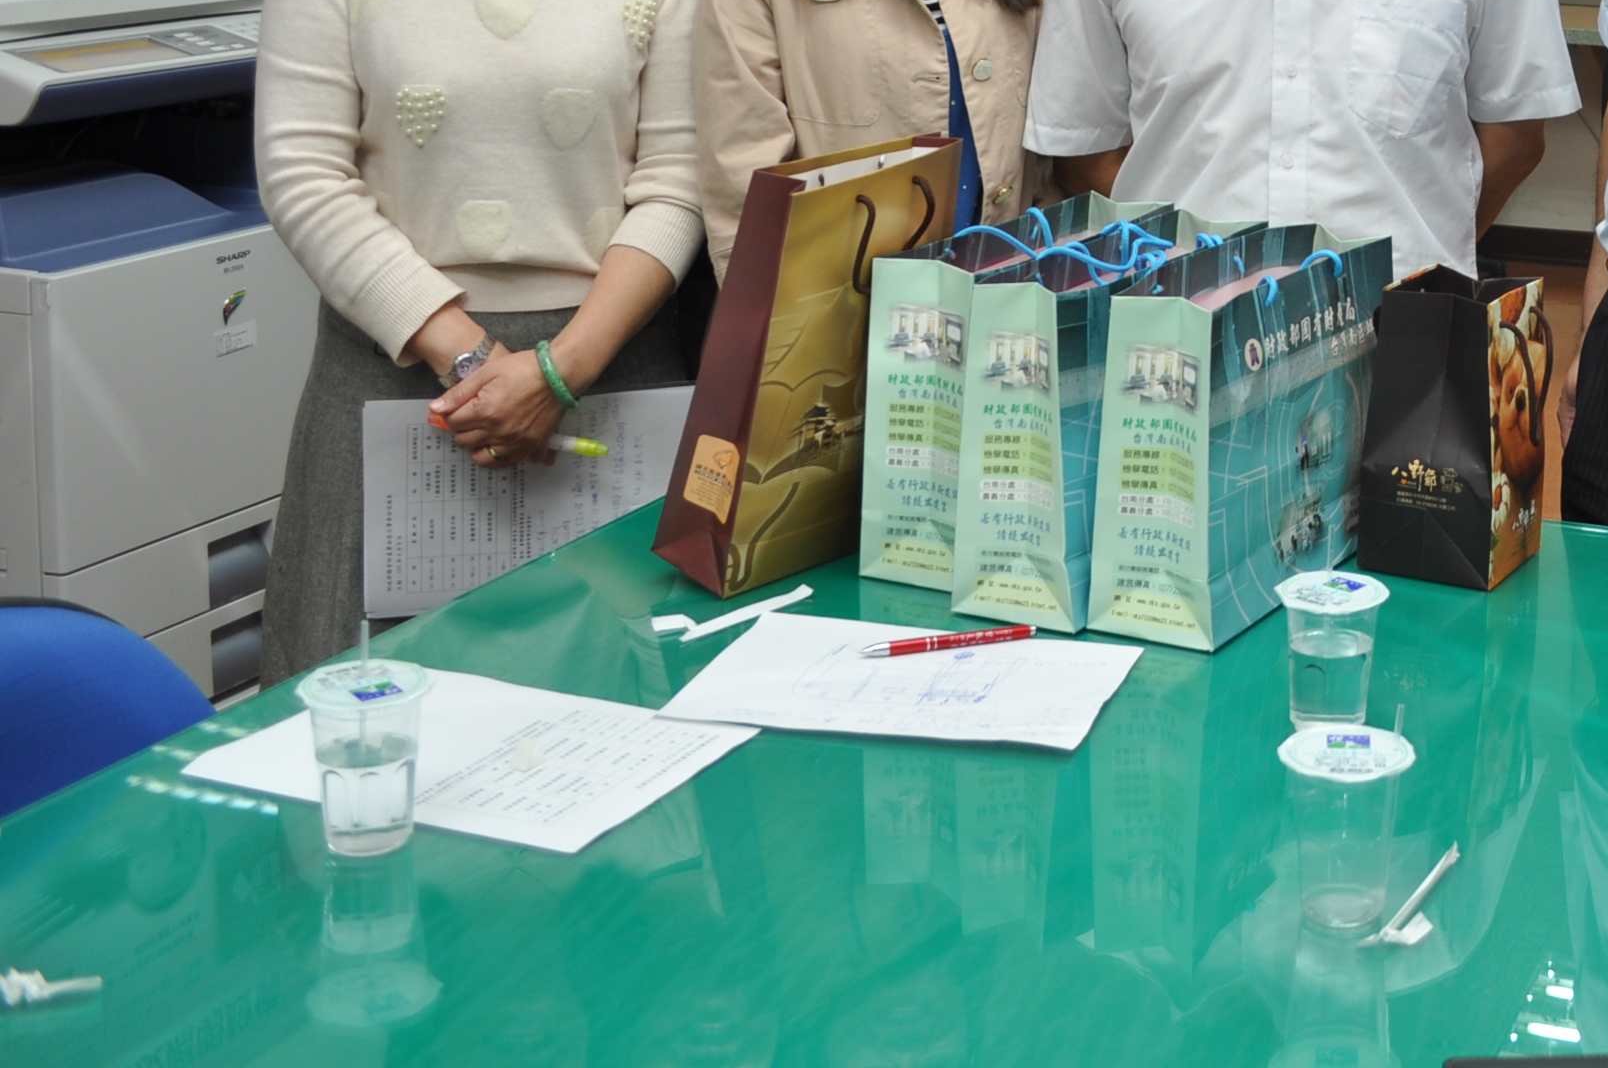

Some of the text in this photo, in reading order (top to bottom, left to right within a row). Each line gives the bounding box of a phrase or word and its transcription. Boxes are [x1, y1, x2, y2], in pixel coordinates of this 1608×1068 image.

[216, 249, 251, 265] SHARP
[1264, 296, 1356, 359] 財政部國有財產局
